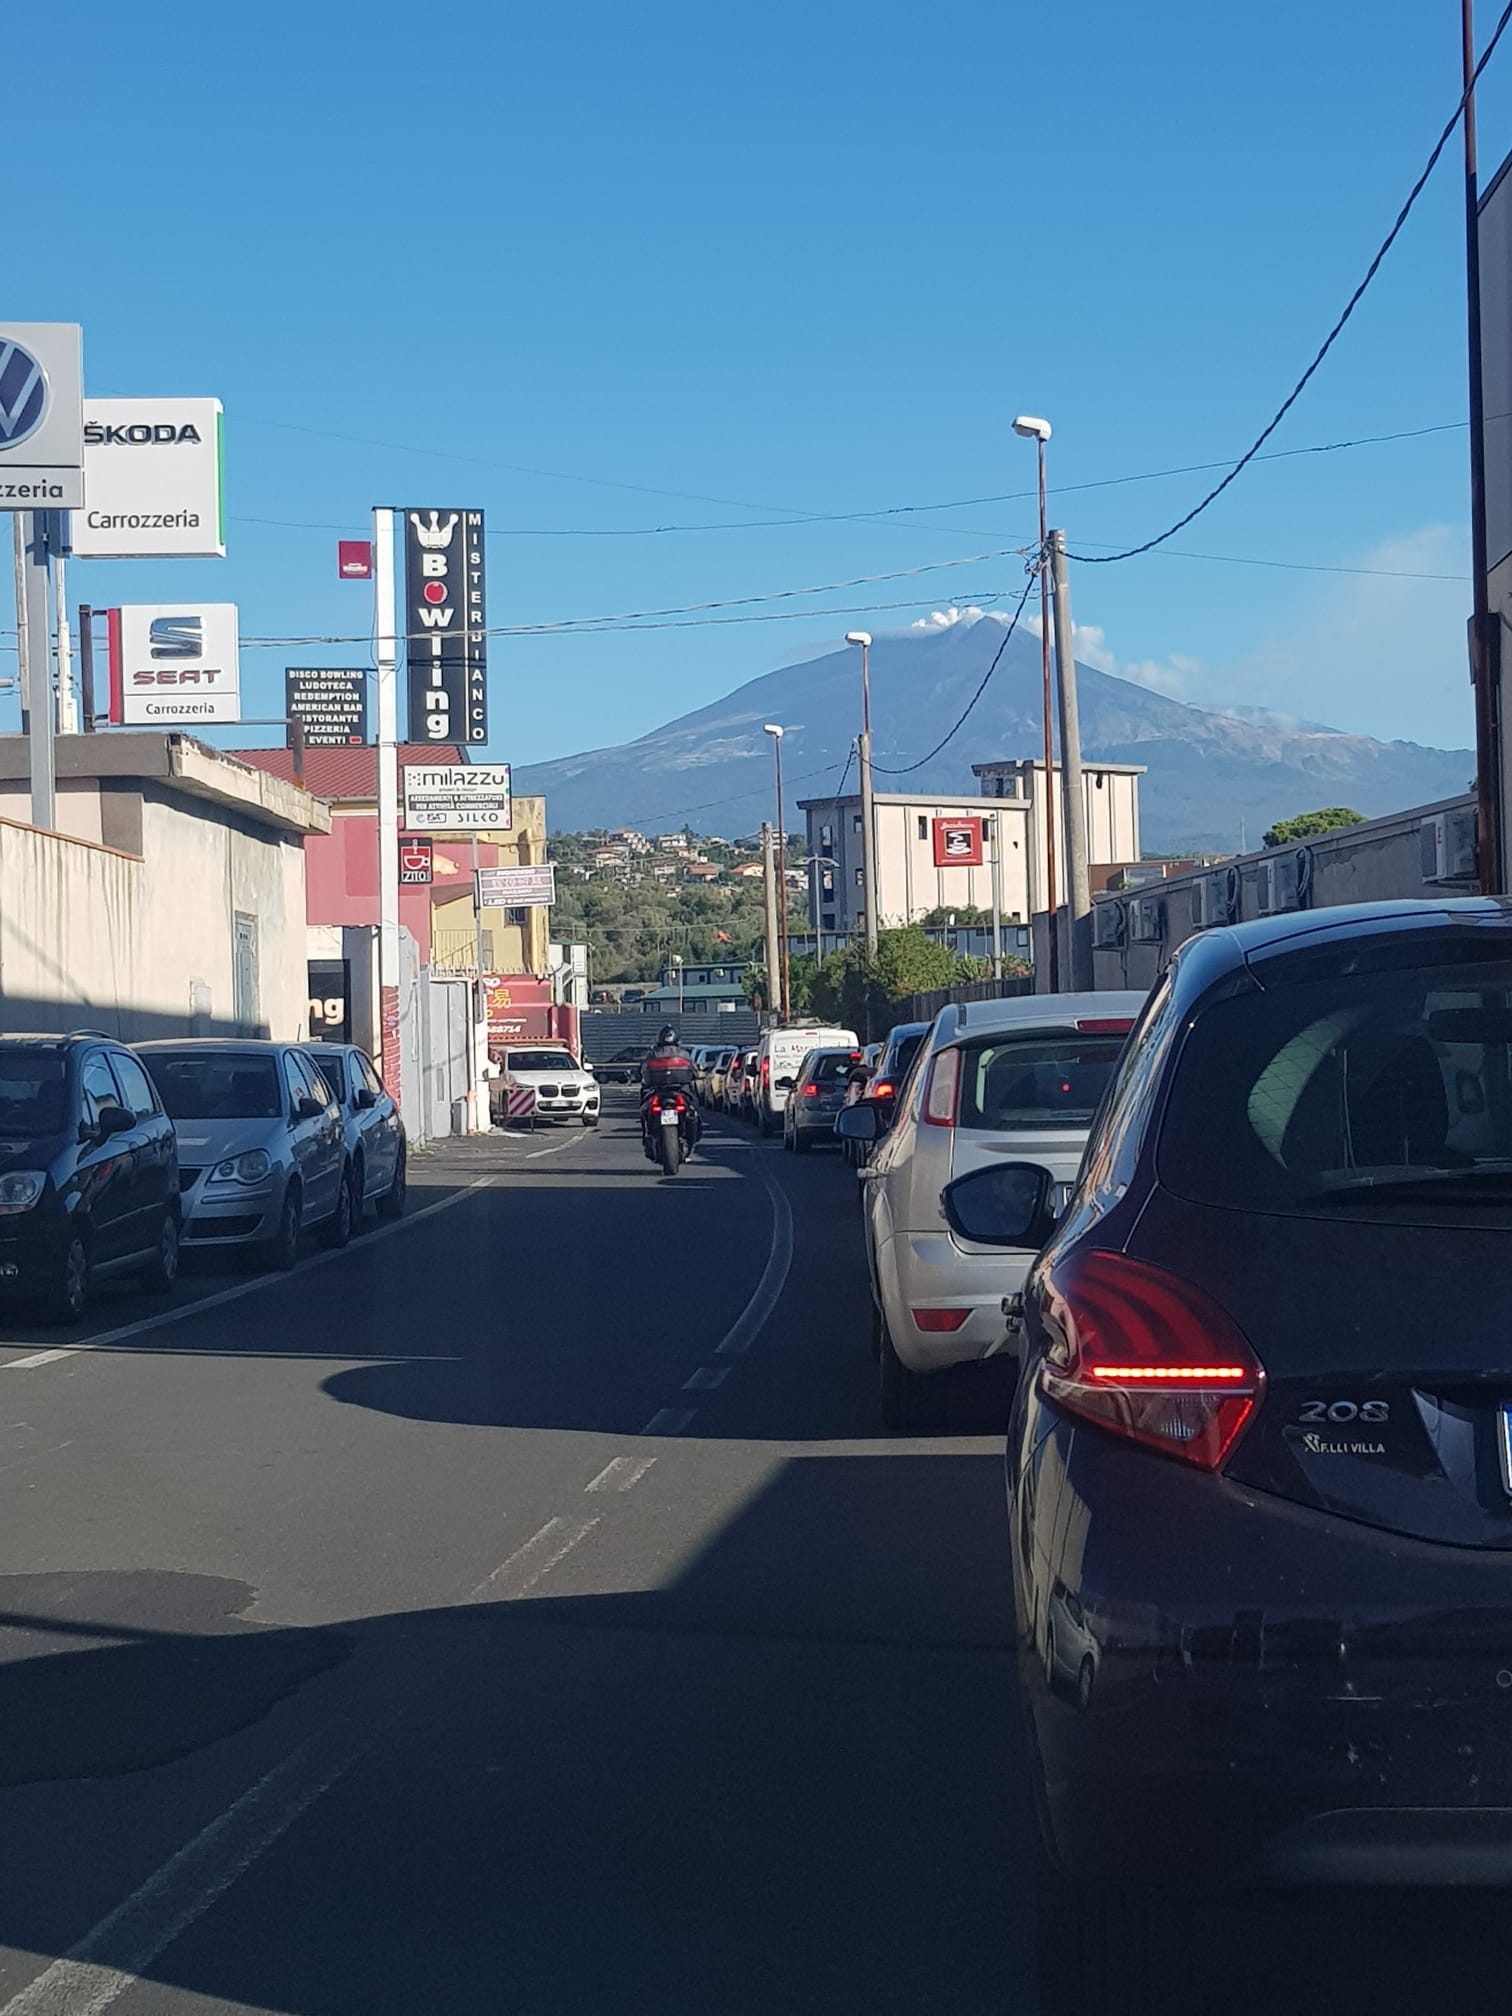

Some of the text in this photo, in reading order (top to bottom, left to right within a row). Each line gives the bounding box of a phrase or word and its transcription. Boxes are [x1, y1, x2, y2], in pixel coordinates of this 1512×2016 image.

[84, 421, 202, 445] ŠKODA
[87, 509, 200, 529] Carrozzeria
[468, 513, 486, 741] MISTERBIANCO
[132, 669, 222, 685] SEAT
[289, 670, 364, 679] DISCO BOWLING
[300, 681, 354, 690] LUDOTECA
[294, 692, 360, 701] REDEMPTION
[145, 702, 216, 715] Carrozzeria
[290, 703, 363, 712] AMERICAN BAR
[296, 714, 359, 723] ISTORANTE
[303, 725, 351, 733] PIZZERIA
[309, 736, 346, 744] EVENTI
[1299, 1401, 1390, 1422] 208
[1350, 1443, 1386, 1453] VILLA
